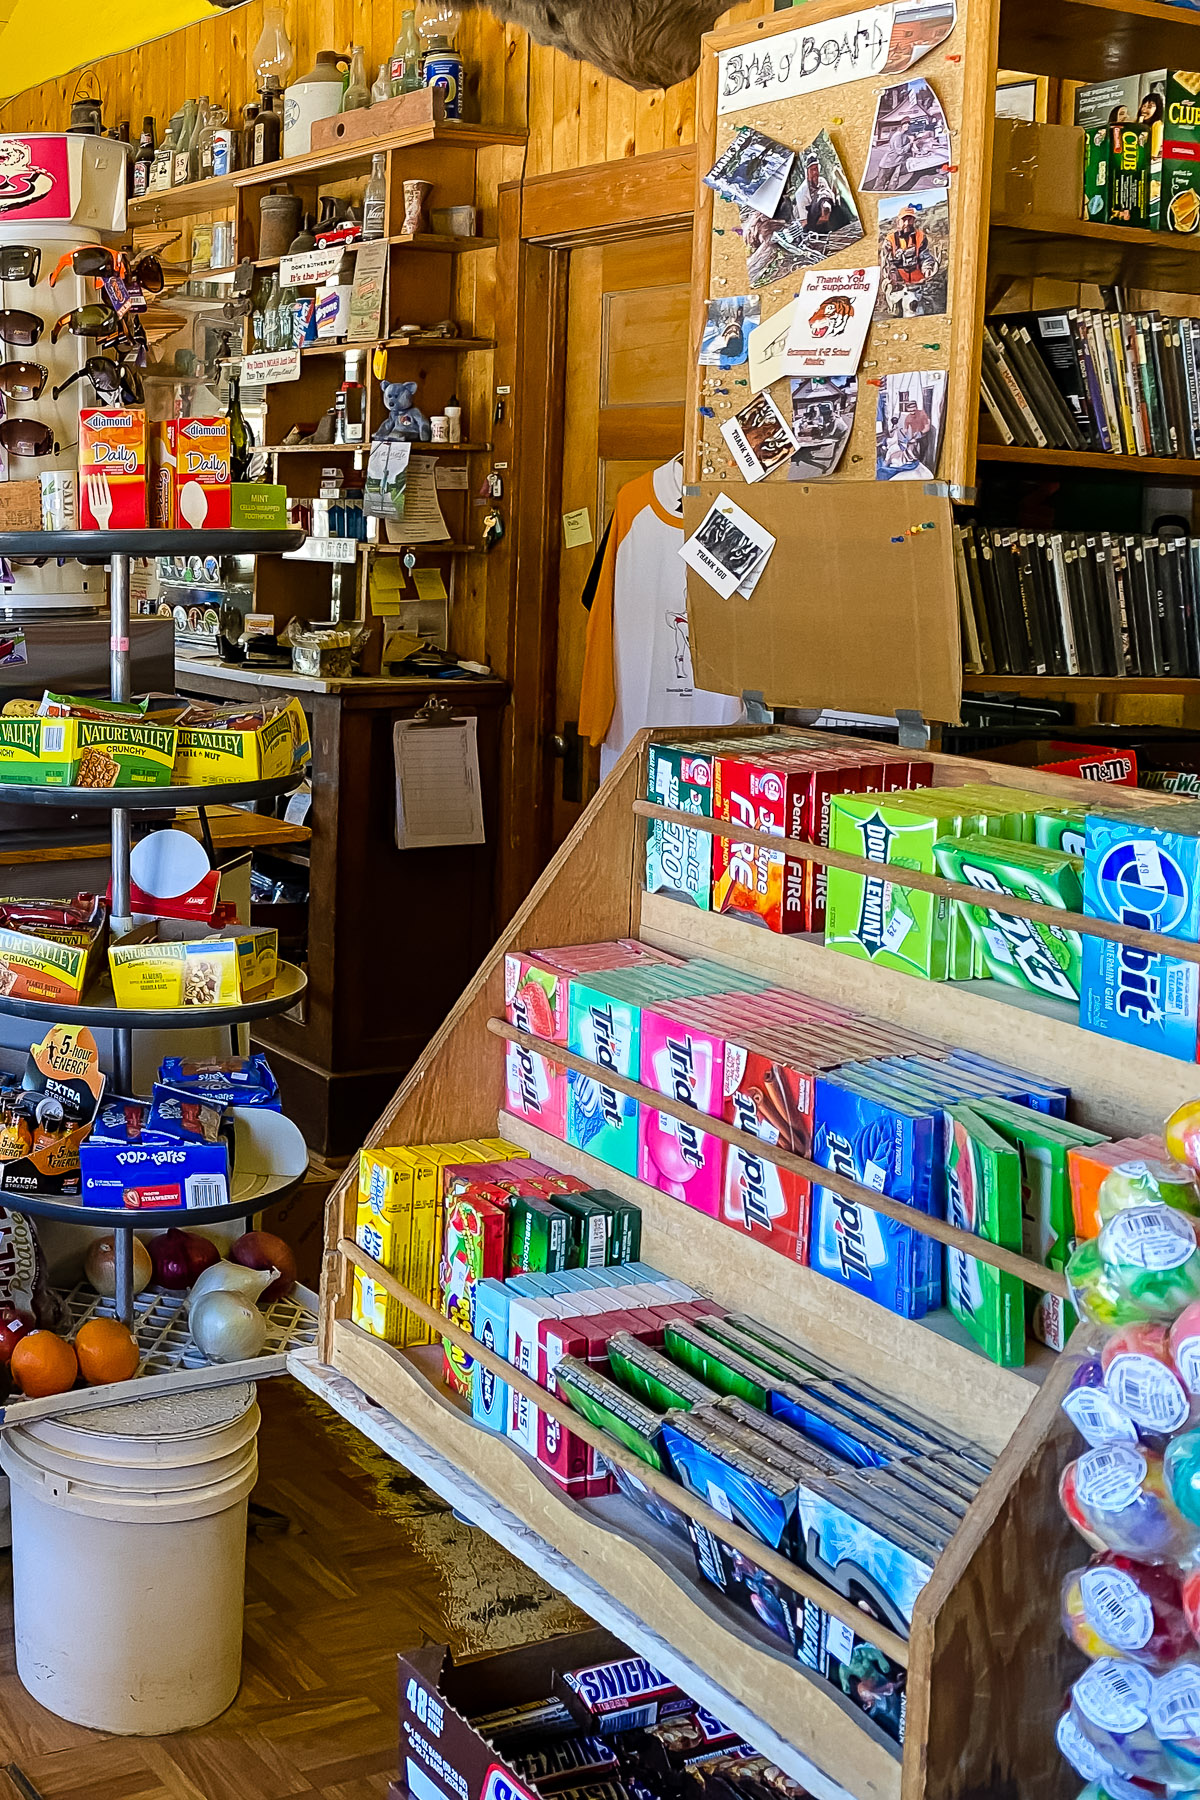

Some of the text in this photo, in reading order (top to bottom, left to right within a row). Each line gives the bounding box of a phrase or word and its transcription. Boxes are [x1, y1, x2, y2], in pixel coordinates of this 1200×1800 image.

[709, 131, 751, 179] THANK YOU
[1123, 131, 1139, 171] CLUB
[806, 282, 870, 292] for supporting
[816, 275, 865, 284] Thank You
[92, 413, 133, 428] diamond
[190, 424, 226, 436] diamond
[92, 442, 137, 475] Daily
[731, 428, 755, 468] THANK YOU
[186, 451, 228, 482] Daily
[239, 504, 280, 512] CELLO-WRAPPED
[250, 494, 269, 503] MINT
[244, 513, 275, 521] TOOTHPICKS
[696, 549, 728, 580] THANK YOU
[1, 722, 39, 753] VALLEY
[81, 723, 173, 751] NATURE VALLEY
[106, 745, 147, 757] CRUNCHY
[178, 730, 241, 752] URE VALLEY
[204, 751, 221, 762] NUT
[686, 789, 702, 892] Deyne ICE
[730, 790, 756, 891] FRE
[757, 805, 775, 895] Detyne
[786, 860, 802, 912] FIRE
[2, 953, 47, 971] CRUNCHY
[30, 942, 78, 972] VALLEY
[115, 943, 187, 964] NATURE VALLEY
[26, 979, 62, 994] PEANUT BUTTER
[142, 972, 163, 980] ALMOND
[1104, 941, 1116, 1011] NTERMINT GUM
[59, 1034, 94, 1060] 5-hour
[511, 996, 542, 1115] Tridnt
[53, 1056, 90, 1076] ENERGY
[590, 1002, 624, 1130] Tridnt
[46, 1079, 81, 1104] EXTRA
[666, 1033, 706, 1170] Tridnt
[0, 1137, 25, 1151] 5-hour
[895, 1118, 904, 1177] ORIGINAL FLAVOR
[732, 1089, 774, 1233] Tridnt
[5, 1175, 38, 1185] EXTRA
[86, 1177, 94, 1188] 6
[368, 1162, 381, 1215] BUBBLE
[376, 1175, 386, 1208] GUM
[141, 1193, 179, 1203] STRAWBERRY
[827, 1129, 874, 1283] Tridnt
[523, 1212, 532, 1272] BUBBLICIOUS
[518, 1344, 531, 1430] BEEANS
[580, 1657, 675, 1704] SNICK
[406, 1678, 428, 1724] 48
